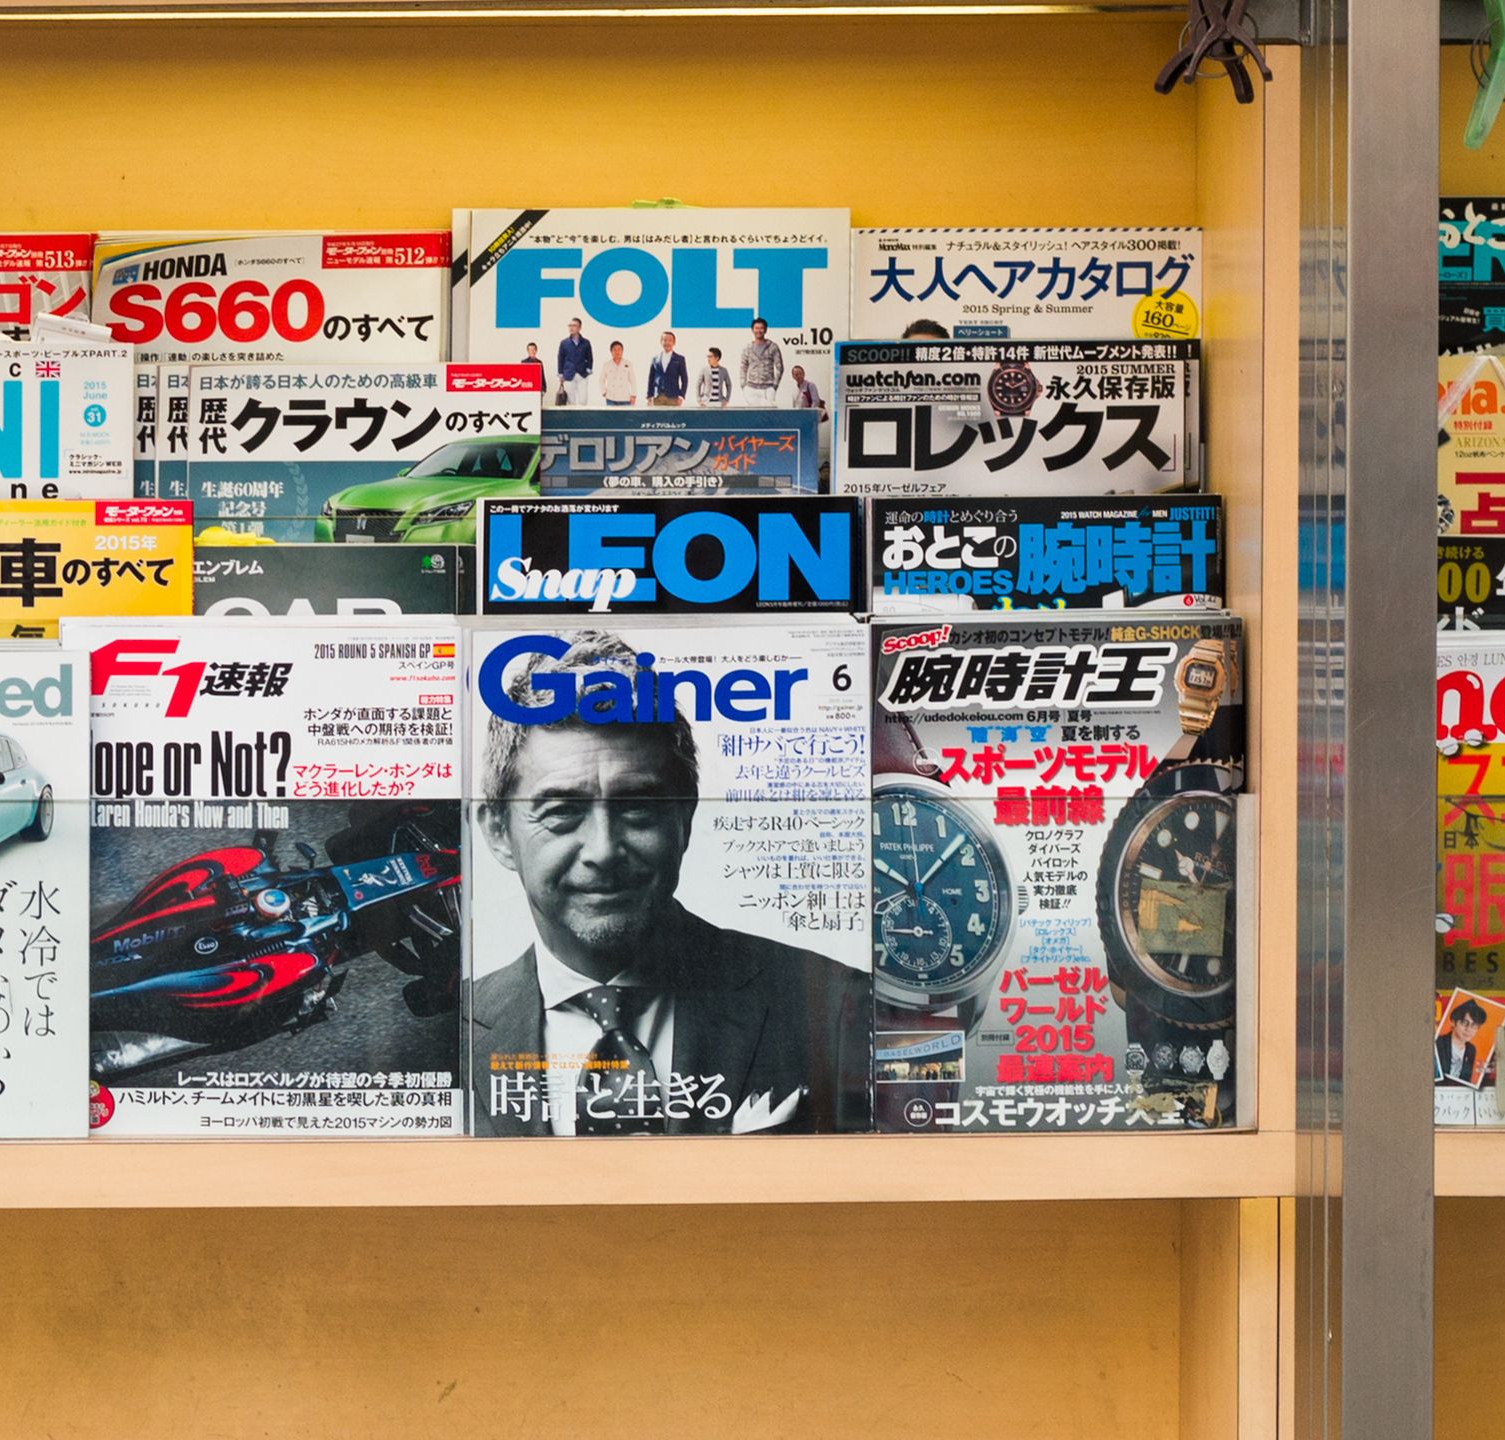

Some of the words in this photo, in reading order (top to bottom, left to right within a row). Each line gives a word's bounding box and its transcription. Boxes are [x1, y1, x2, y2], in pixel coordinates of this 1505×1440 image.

[142, 253, 227, 281] HONDA
[870, 254, 1195, 303] 大人ヘアカタログ
[495, 247, 828, 329] FOLT
[963, 304, 987, 314] 2015
[991, 304, 1030, 316] Spring
[1034, 304, 1043, 314] &
[1046, 304, 1093, 314] Summer
[783, 335, 808, 346] vol.
[810, 328, 833, 346] 10
[847, 349, 910, 362] SCOOP!!
[199, 373, 438, 390] 日本が誇る日本人のための高級車
[846, 372, 981, 388] watchfan.com
[1047, 377, 1175, 400] 永久保存版
[231, 397, 441, 452] クラウン
[445, 410, 533, 431] のすべて
[201, 480, 284, 499] 生誕60周年
[489, 511, 851, 603] LEON
[62, 558, 174, 587] のすべて
[491, 557, 636, 612] Snap
[884, 571, 1018, 596] HEROES
[478, 634, 808, 726] Gainer
[887, 646, 1177, 708] 腕時計王
[90, 730, 153, 799] ope
[163, 740, 201, 796] or
[212, 730, 291, 798] Not?
[293, 764, 453, 779] マクラーレン・ホンダは
[939, 745, 1158, 785] スポーツモデル
[723, 863, 866, 880] シャツは上質に限る
[20, 880, 60, 1037] 水冷では
[1016, 1026, 1095, 1053] 2015
[490, 1071, 735, 1122] 時計と生きる
